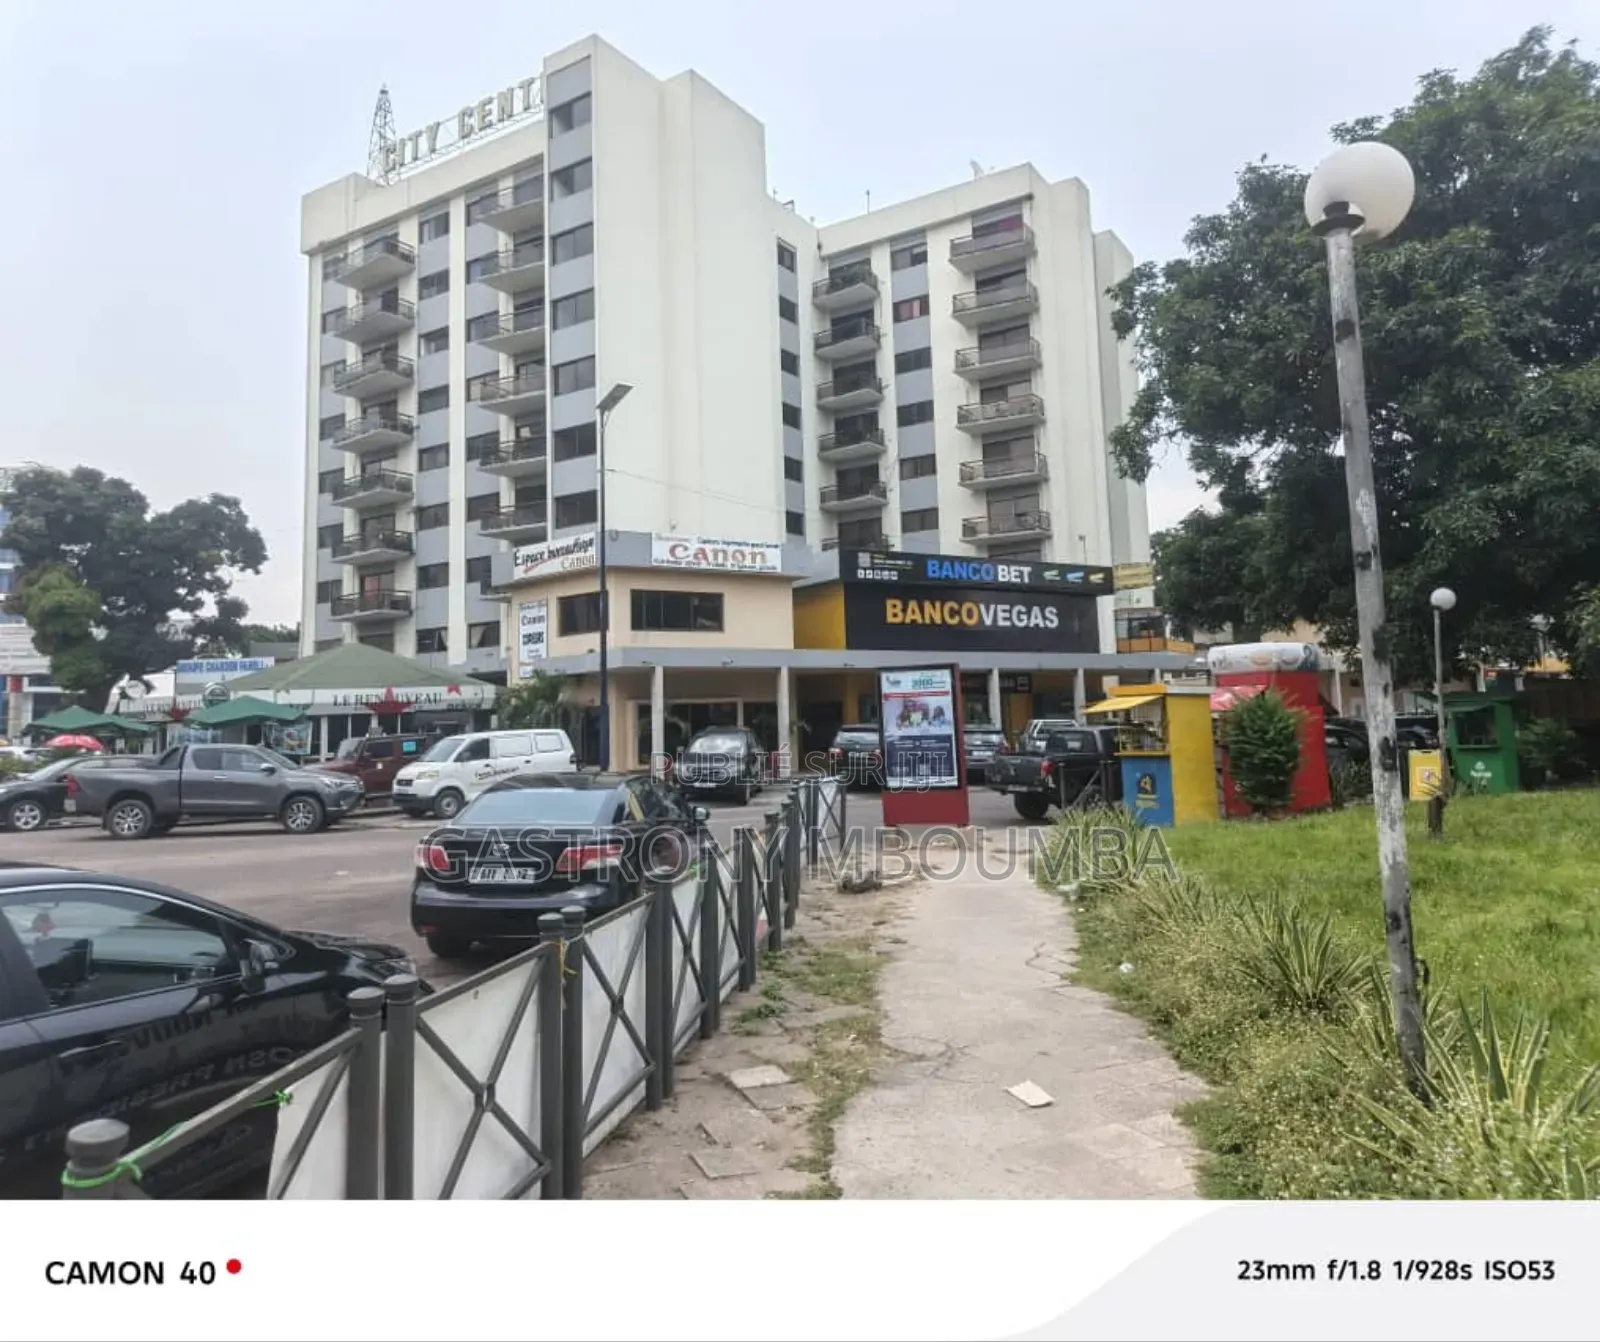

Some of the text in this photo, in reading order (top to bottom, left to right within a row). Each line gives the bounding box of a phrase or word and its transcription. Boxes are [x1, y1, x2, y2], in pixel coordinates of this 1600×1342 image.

[382, 120, 440, 174] CITY
[669, 543, 767, 564] Canon
[885, 598, 1059, 629] BANCOVEGAS
[333, 694, 352, 706] LE
